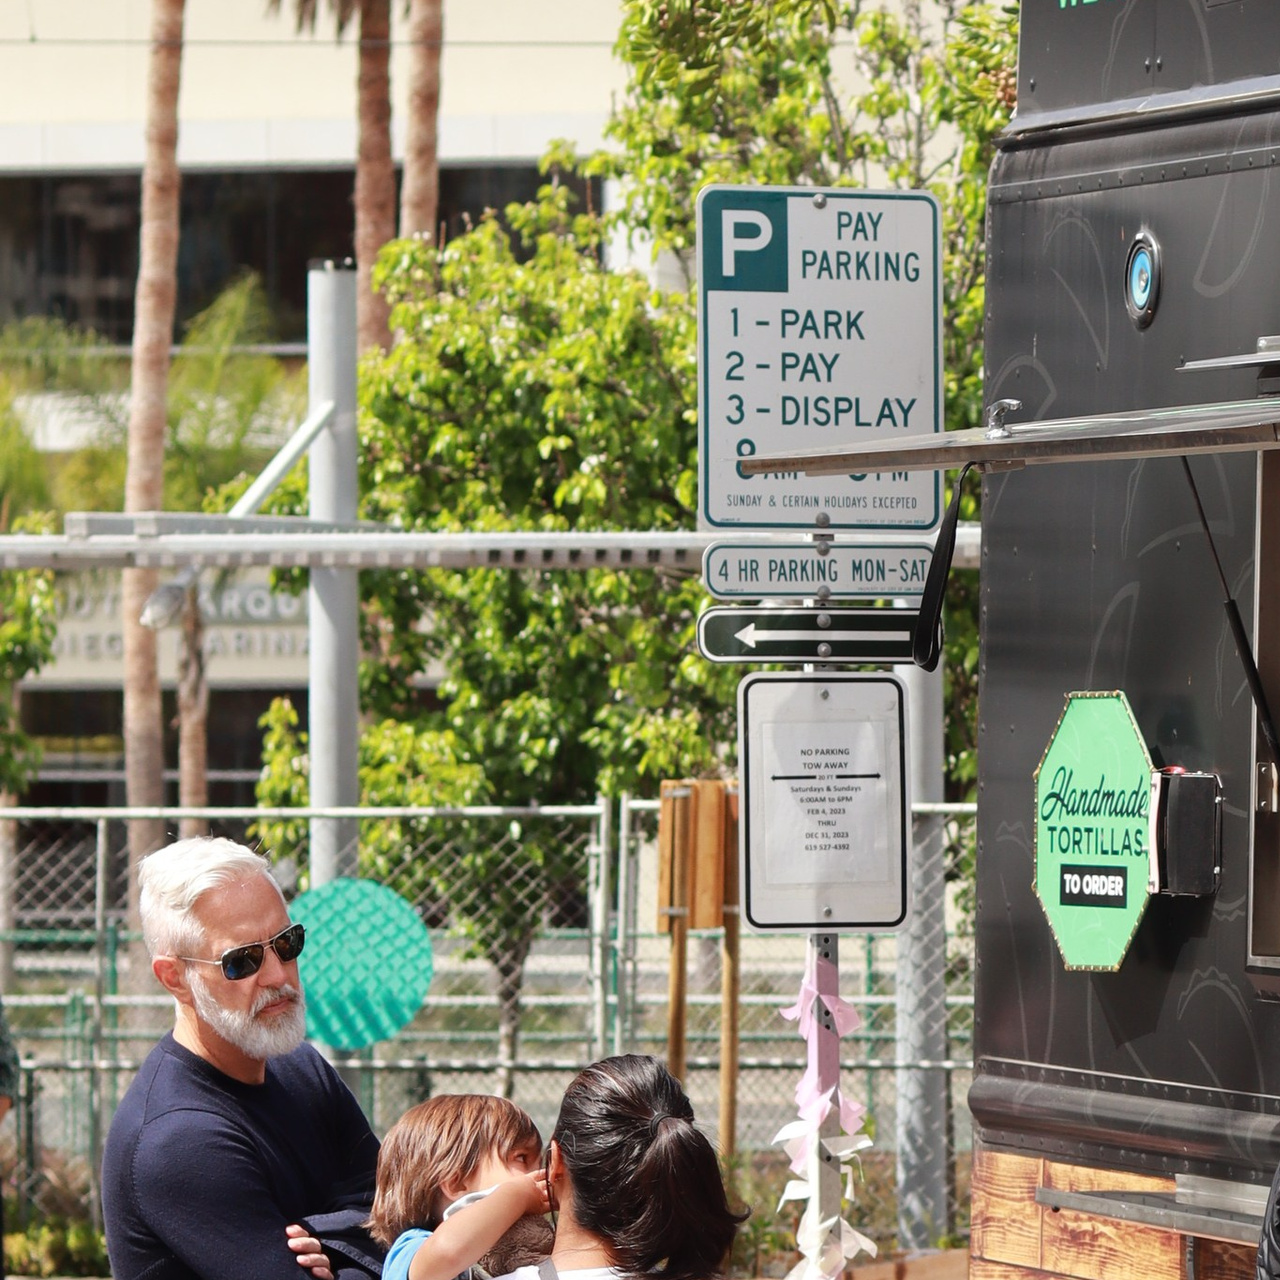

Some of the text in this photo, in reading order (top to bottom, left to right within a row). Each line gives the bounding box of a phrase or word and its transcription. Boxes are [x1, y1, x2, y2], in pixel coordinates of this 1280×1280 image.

[838, 211, 884, 242] PAY
[721, 209, 773, 278] P
[802, 250, 920, 283] PARKING
[731, 307, 739, 337] 1
[781, 309, 866, 340] PARK
[725, 351, 745, 382] 2
[782, 352, 841, 382] PAY
[726, 394, 746, 426] 3
[782, 396, 918, 427] DISPLAY
[726, 494, 918, 510] SUNDAY & CERTAIN HOLIDAYS EXCEPTED
[718, 559, 927, 582] 4 HR PARKING MON-SAT
[800, 748, 850, 756] NO PARKING
[802, 761, 849, 770] TOW AWAY
[790, 785, 824, 794] Saturdays
[833, 785, 862, 794] Sundays
[799, 796, 826, 804] 6:00AM
[1041, 766, 1149, 822] Handmade
[829, 807, 846, 815] 2023
[819, 843, 850, 851] 527-4392
[821, 831, 831, 840] 31,
[1047, 825, 1144, 858] TORTILLAS
[1063, 873, 1124, 897] TO ORDER
